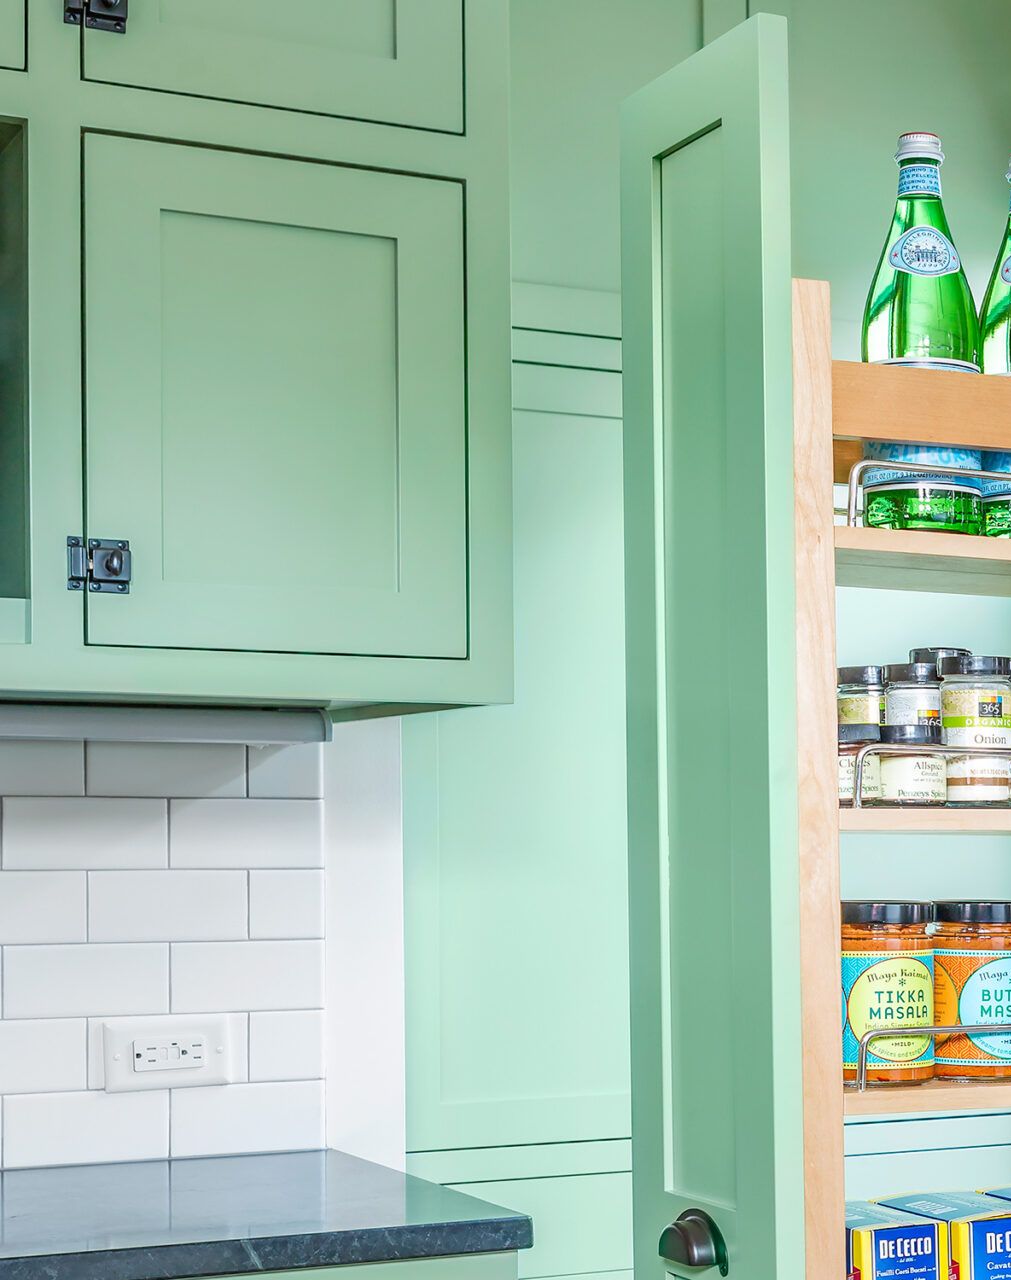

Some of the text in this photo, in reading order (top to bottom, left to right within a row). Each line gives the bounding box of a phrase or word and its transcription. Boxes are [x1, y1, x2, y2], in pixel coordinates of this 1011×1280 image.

[981, 703, 1000, 714] 365
[965, 718, 1011, 727] ORGANIC
[974, 734, 1007, 744] Onion
[839, 758, 871, 768] Cloes
[867, 971, 897, 982] Maya
[980, 970, 1008, 981] Maya
[874, 989, 924, 1003] TIKKA
[869, 1005, 928, 1020] MASALA
